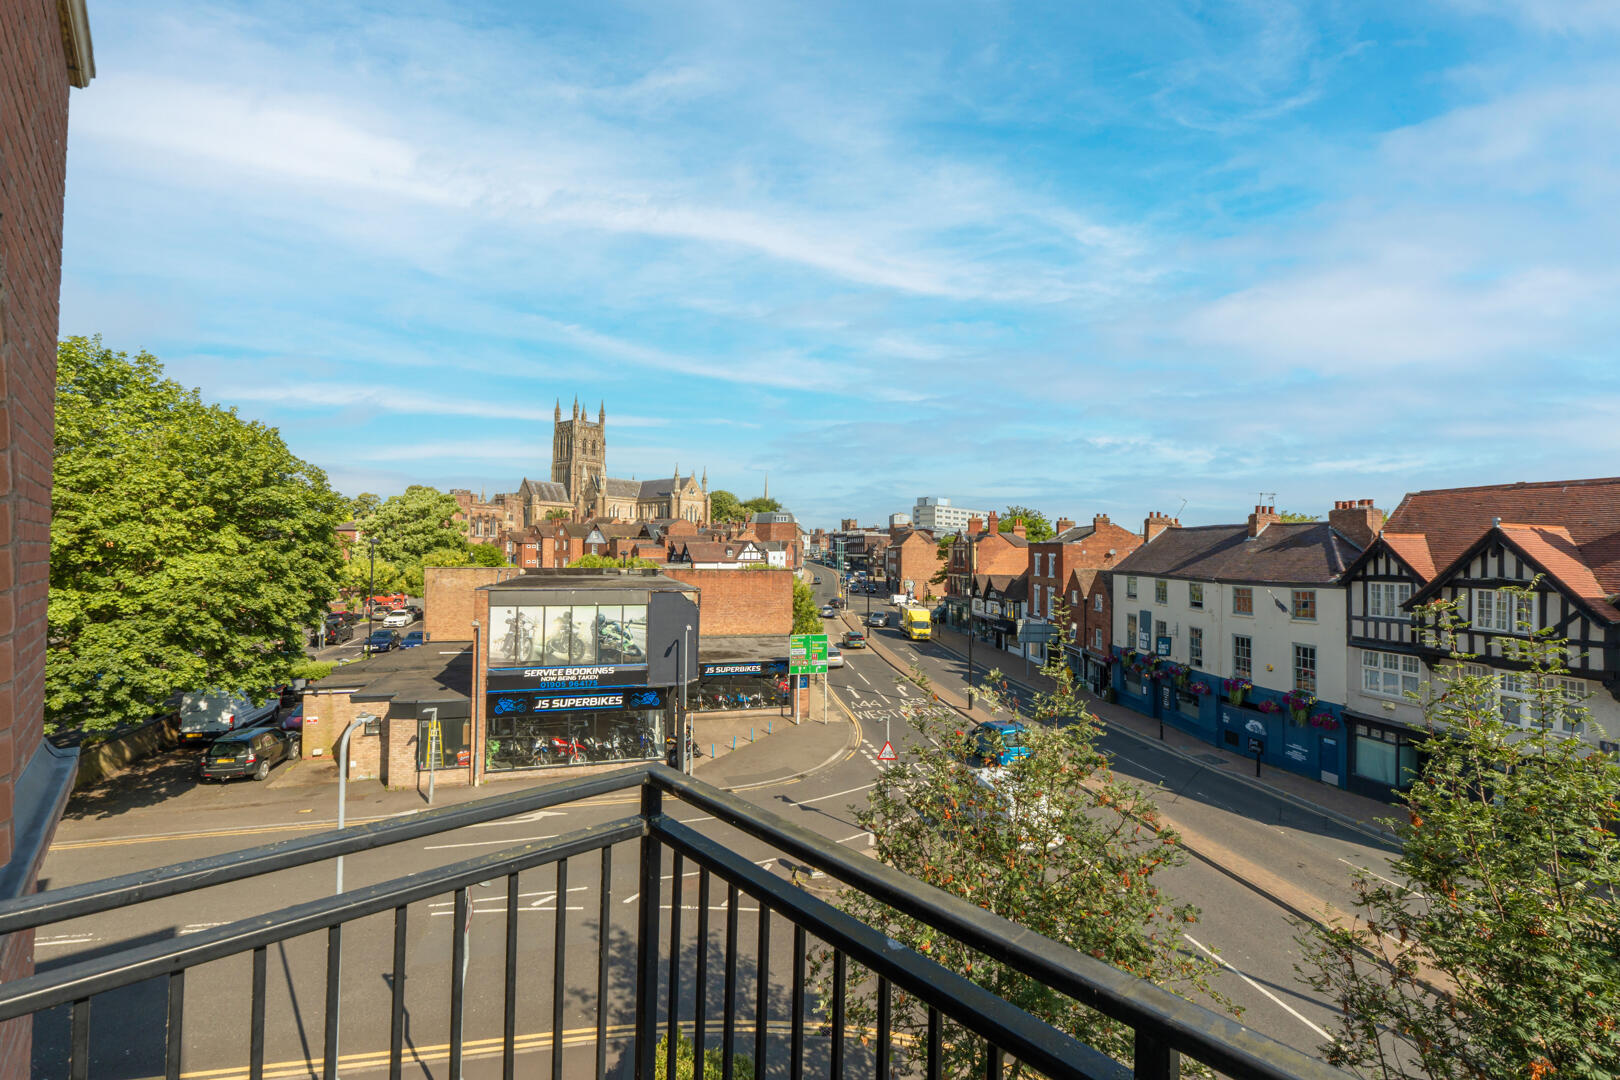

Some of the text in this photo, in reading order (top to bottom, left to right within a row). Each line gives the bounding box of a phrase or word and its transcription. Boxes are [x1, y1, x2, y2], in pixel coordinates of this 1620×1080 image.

[524, 667, 615, 677] SERVICE BOOKINGS
[535, 696, 623, 709] JS SUPERBIKES
[853, 710, 898, 719] WEST
